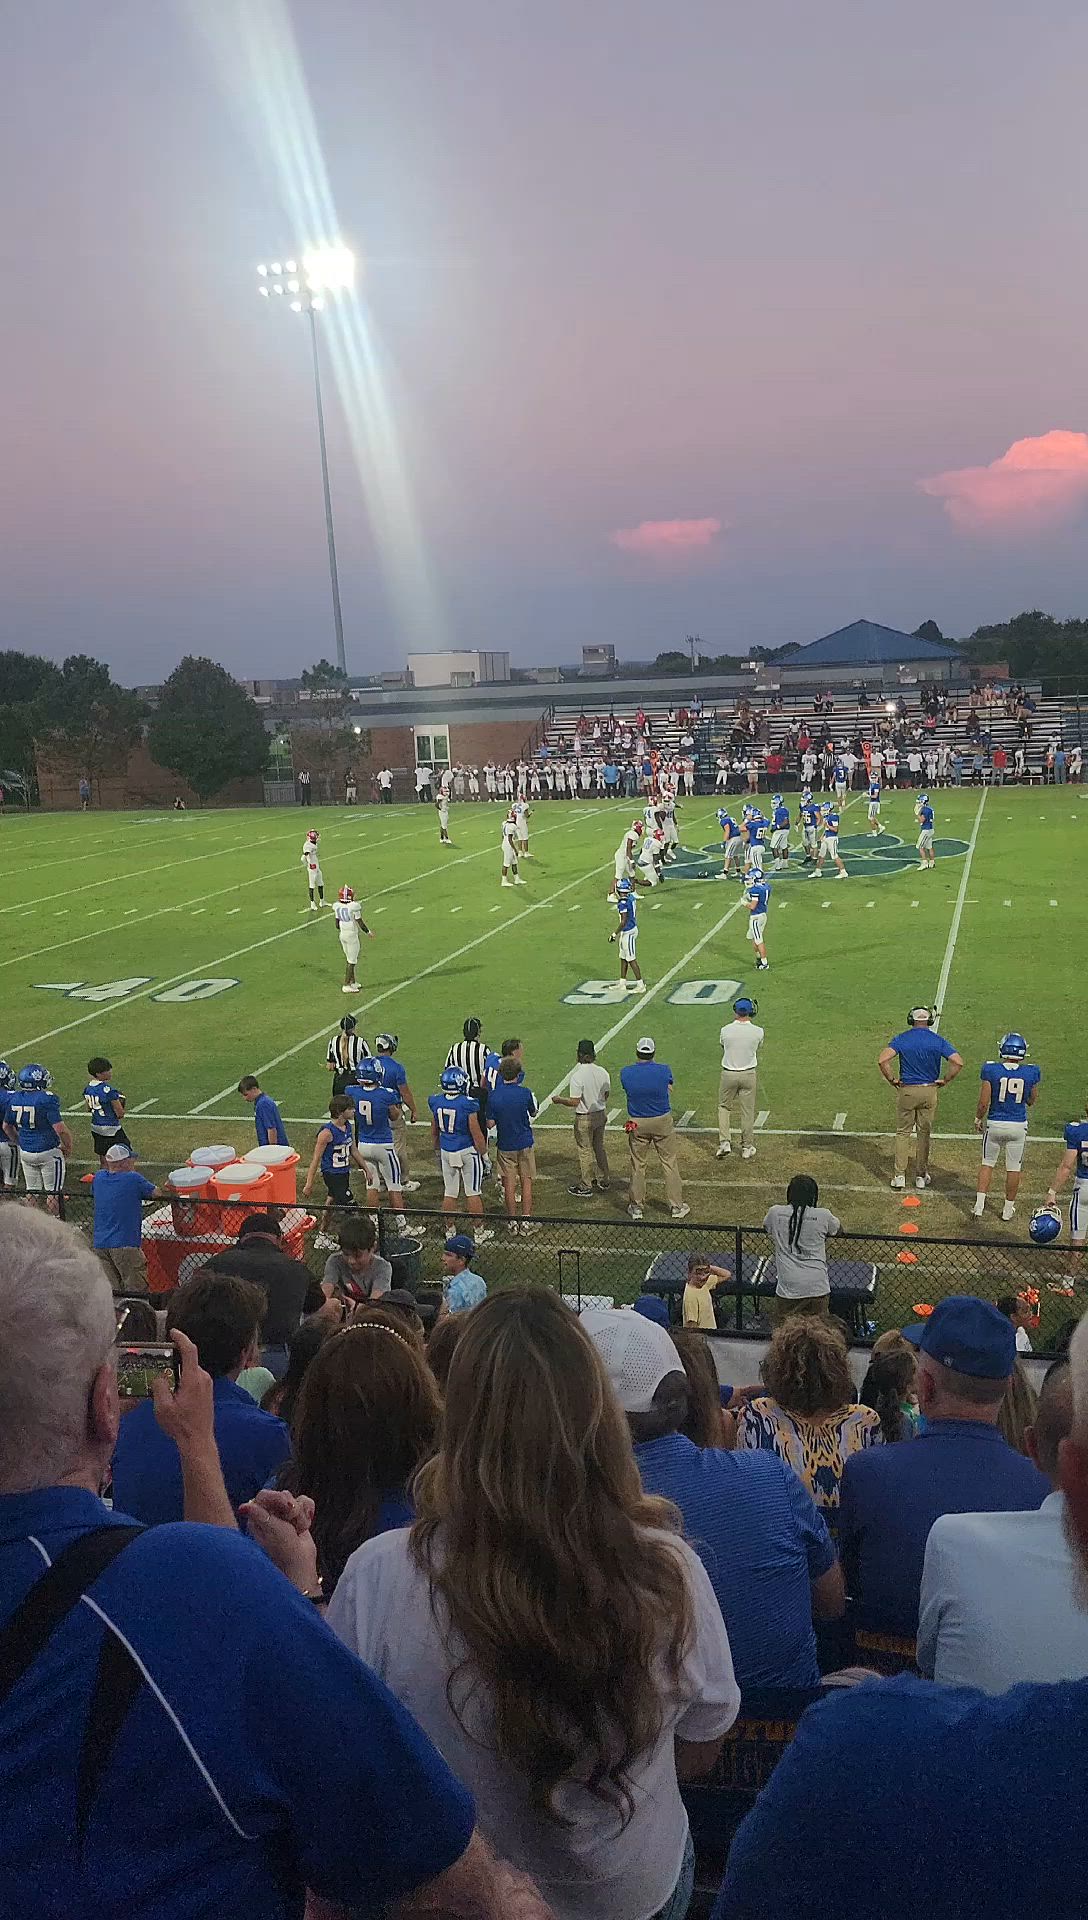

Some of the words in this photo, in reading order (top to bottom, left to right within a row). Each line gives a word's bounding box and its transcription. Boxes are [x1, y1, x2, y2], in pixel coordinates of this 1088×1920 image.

[998, 1076, 1024, 1104] 19
[11, 1105, 36, 1129] 77
[358, 1100, 373, 1126] 9
[437, 1108, 457, 1134] 17
